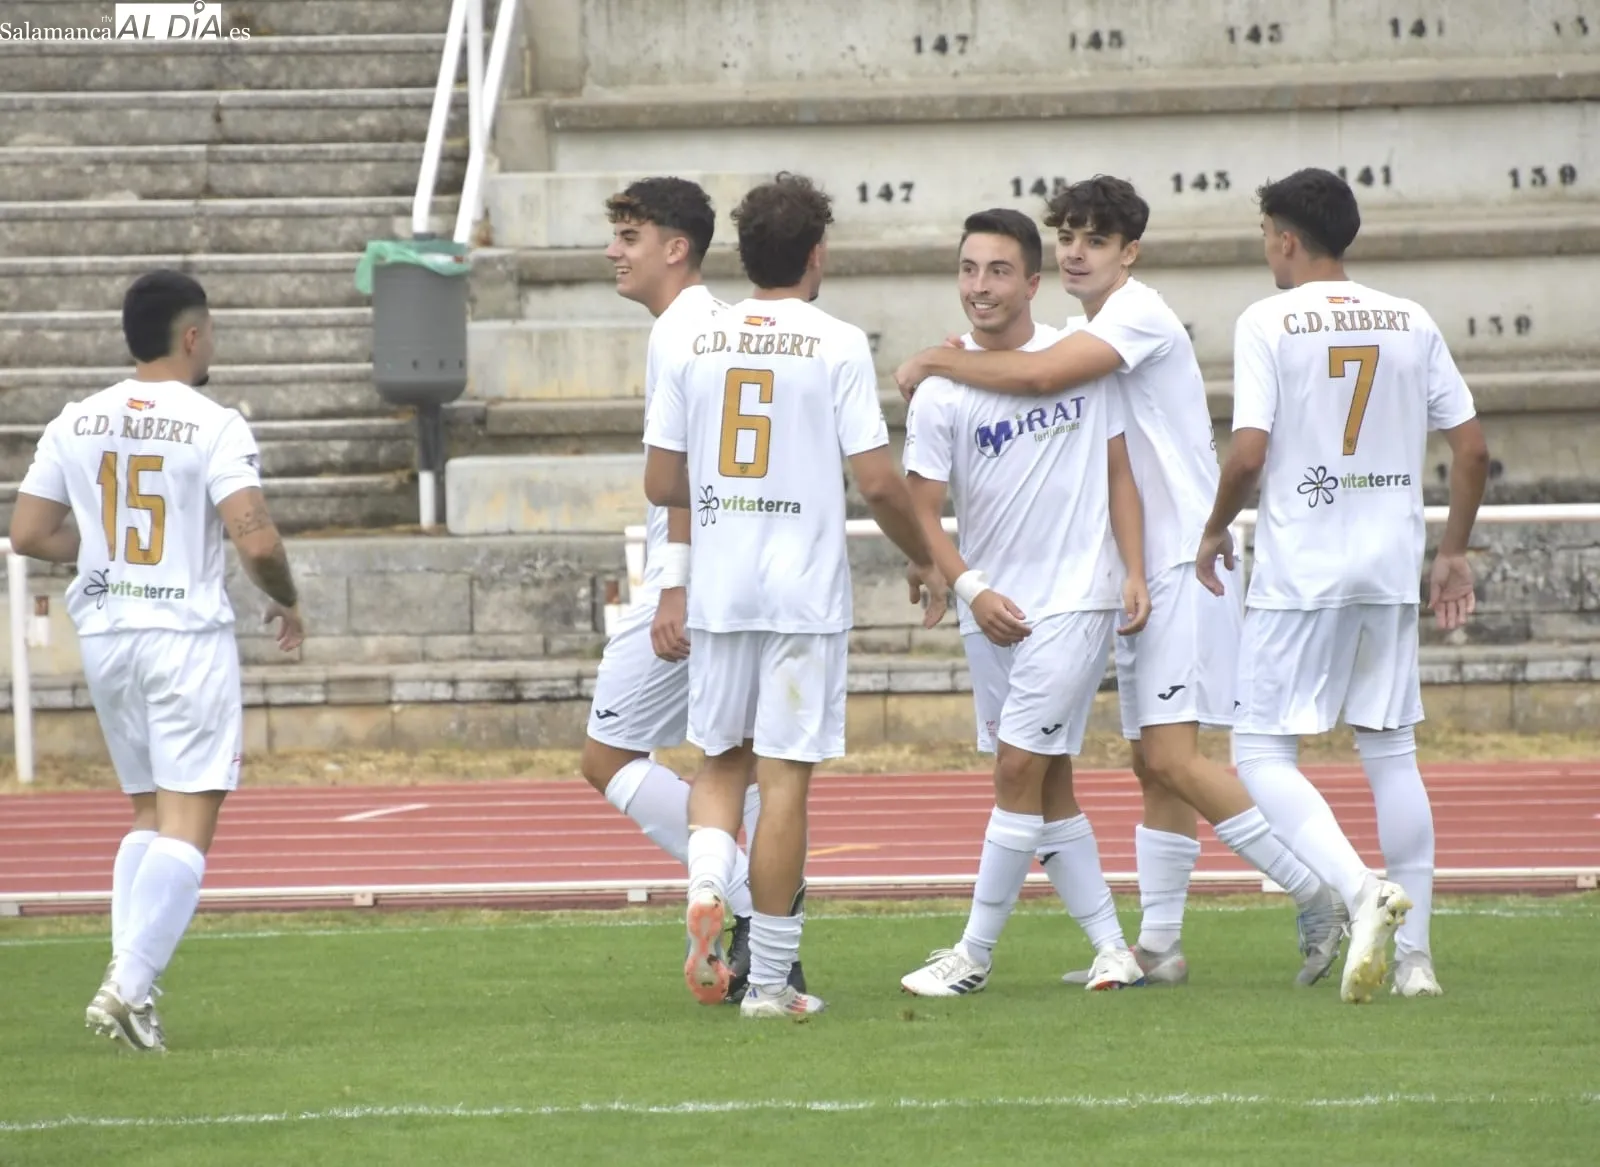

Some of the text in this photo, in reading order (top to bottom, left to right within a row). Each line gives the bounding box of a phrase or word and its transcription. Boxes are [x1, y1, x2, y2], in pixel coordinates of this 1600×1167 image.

[914, 34, 969, 55] 147
[857, 181, 915, 204] 147
[1283, 310, 1411, 335] C.D. RIBERT
[692, 331, 821, 358] C.D. RIBERT
[1328, 344, 1380, 456] 7
[73, 414, 200, 445] C.D. RIBERT
[718, 367, 775, 479] 6
[1340, 473, 1412, 490] vitaterra
[96, 451, 166, 566] 15
[721, 495, 802, 515] vitaterra
[109, 580, 186, 600] vitaterra
